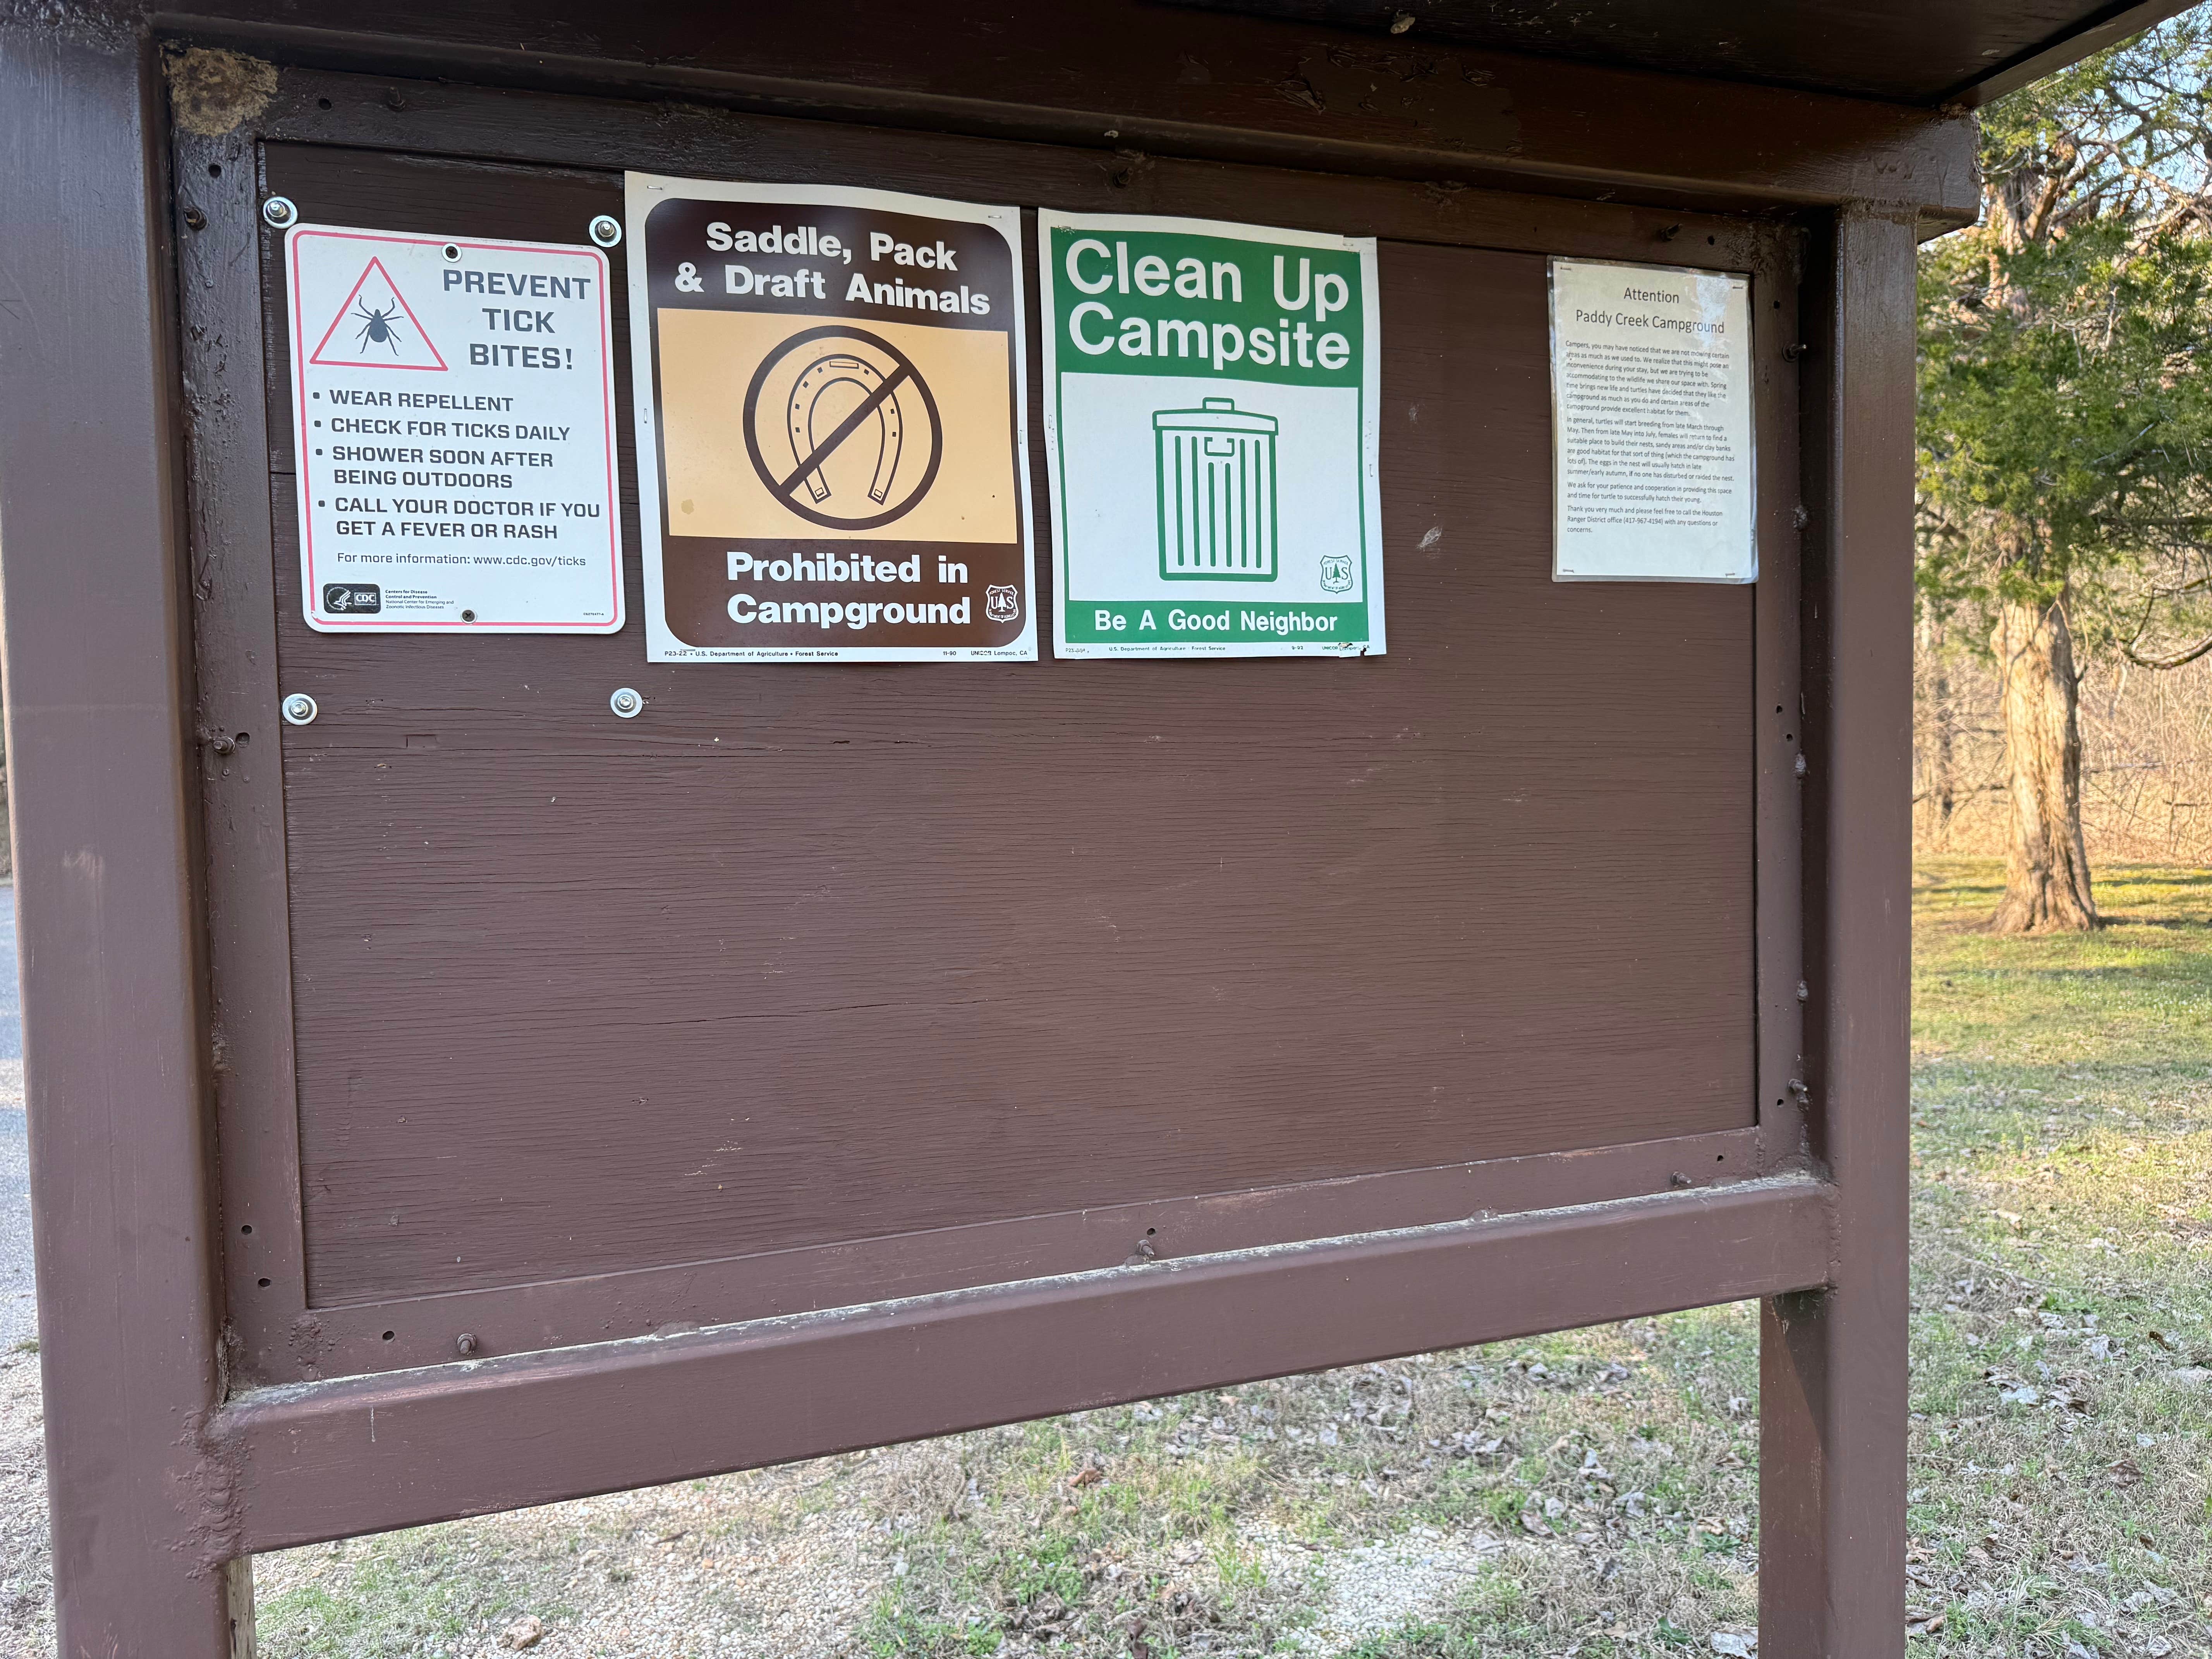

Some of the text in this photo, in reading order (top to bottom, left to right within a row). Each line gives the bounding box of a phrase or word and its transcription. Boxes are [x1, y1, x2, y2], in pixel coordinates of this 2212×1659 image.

[706, 222, 957, 271] Saddle, Pack
[443, 269, 591, 300] PREVENT
[675, 262, 990, 315] & Draft Animals
[1066, 239, 1349, 322] Clean Up
[1623, 287, 1679, 304] Attention
[482, 308, 555, 333] TICK
[1576, 309, 1724, 333] Paddy Creek Campground
[1069, 301, 1350, 371] Campsite
[470, 343, 572, 370] BITES!
[1565, 340, 1590, 349] Campers,
[1690, 350, 1711, 359] mowing
[1566, 373, 1609, 382] accommodating
[1711, 381, 1727, 390] Spring
[329, 389, 514, 412] WEAR REPELLENT
[331, 418, 570, 441] CHECK FOR TICKS DAILY
[1638, 420, 1661, 429] breeding
[1704, 424, 1724, 433] through
[333, 446, 553, 467] SHOWER SOON AFTER
[334, 469, 512, 488] BEING OUTDOORS
[335, 497, 599, 517] CALL YOUR DOCTOR IF YOU
[337, 520, 557, 539] GET A FEVER OR RASH
[1623, 517, 1663, 526] (417-967-4194)
[338, 553, 357, 562] For
[396, 553, 470, 564] information:
[473, 555, 586, 567] www.cdc.gov/ticks
[727, 551, 968, 583] Prohibited in
[356, 594, 376, 603] CDC
[727, 594, 970, 630] Campground
[1095, 609, 1338, 635] Be A Good Neighbor
